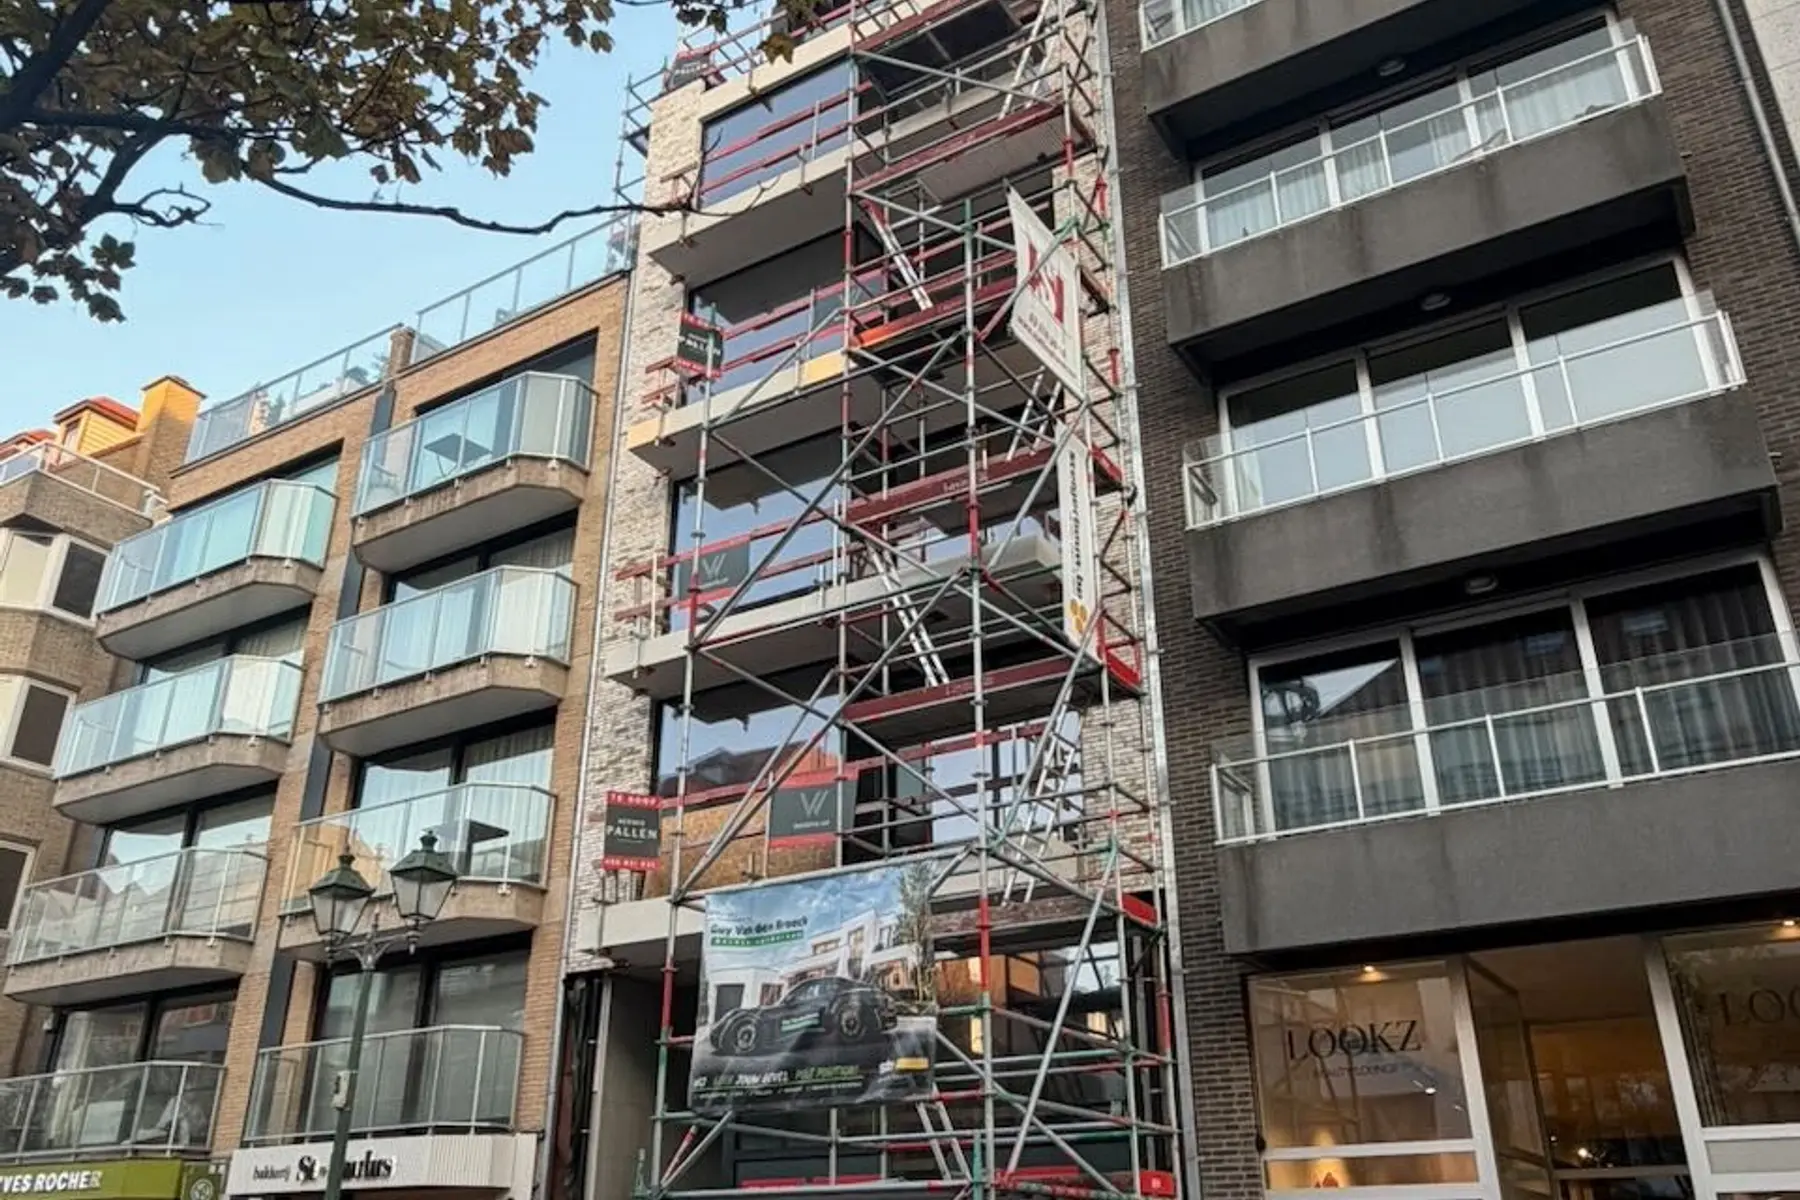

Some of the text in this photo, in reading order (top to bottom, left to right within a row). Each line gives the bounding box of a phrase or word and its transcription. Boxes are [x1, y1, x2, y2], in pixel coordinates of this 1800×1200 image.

[606, 824, 658, 839] PALLEN
[1286, 1019, 1423, 1061] LOOKZ
[33, 1169, 103, 1193] ROCHER
